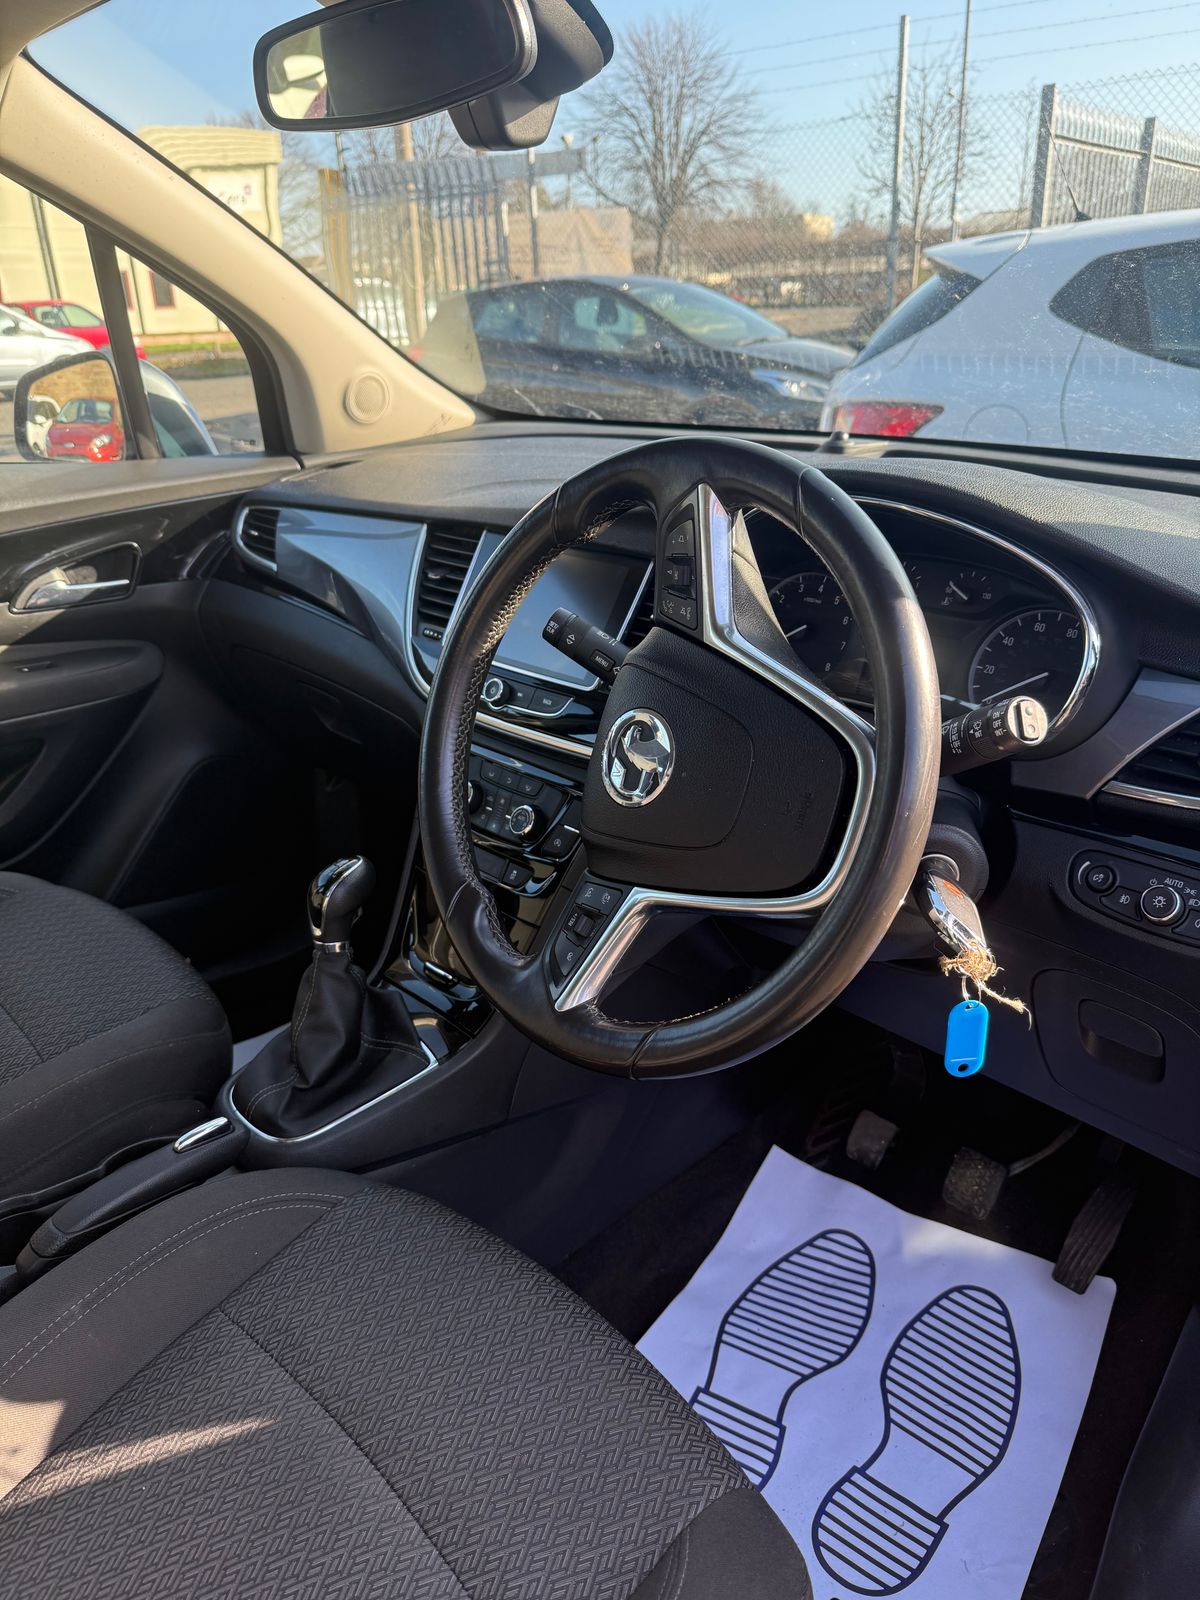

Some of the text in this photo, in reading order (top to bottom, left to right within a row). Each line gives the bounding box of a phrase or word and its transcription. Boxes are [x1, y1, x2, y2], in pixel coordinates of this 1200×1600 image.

[798, 584, 804, 593] 3
[818, 584, 824, 593] 4
[779, 594, 785, 604] 2
[833, 595, 840, 605] 5
[842, 616, 849, 625] 6
[1033, 622, 1046, 633] 60
[1066, 628, 1079, 639] 80
[840, 641, 846, 650] 7
[1002, 636, 1015, 647] 40
[594, 655, 609, 668] MENU
[824, 662, 831, 672] 8
[983, 664, 995, 675] 20
[992, 719, 1002, 729] OFF
[1163, 877, 1184, 889] AUTO
